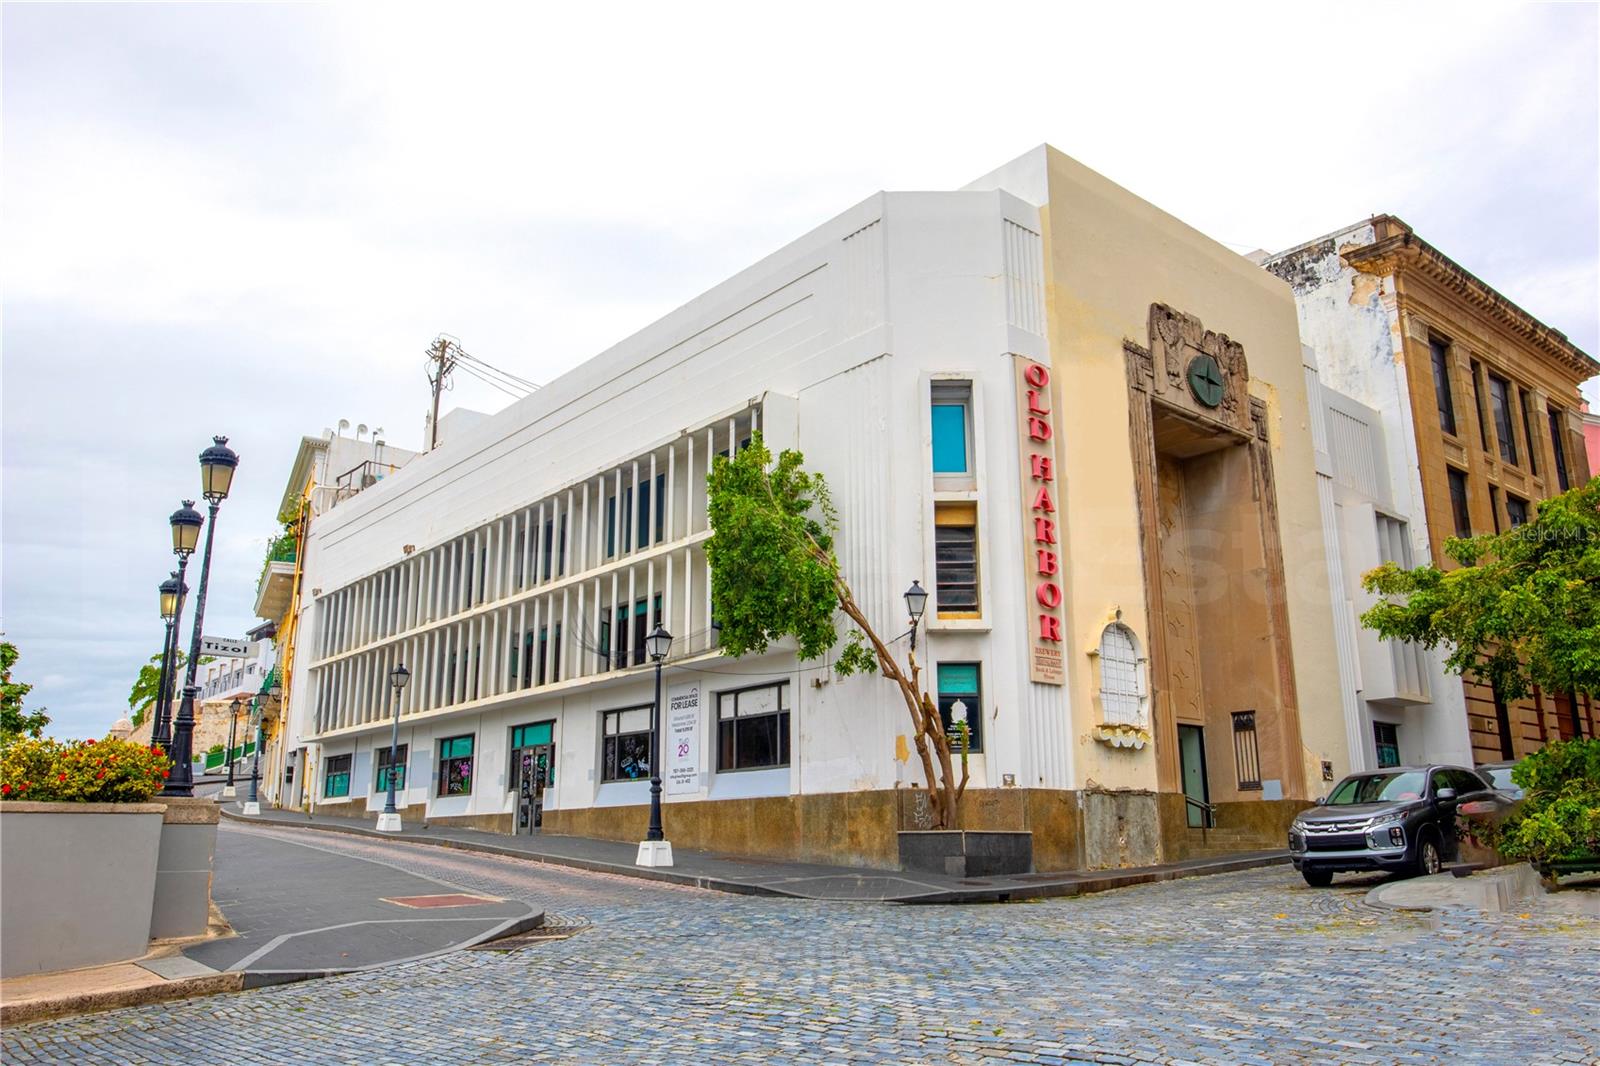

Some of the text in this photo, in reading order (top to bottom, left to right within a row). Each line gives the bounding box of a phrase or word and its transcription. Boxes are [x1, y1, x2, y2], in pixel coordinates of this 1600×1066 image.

[1024, 364, 1062, 641] OLD HARBOR
[204, 641, 247, 654] Tizol
[671, 699, 698, 710] FOR LEASE
[678, 743, 689, 757] 20
